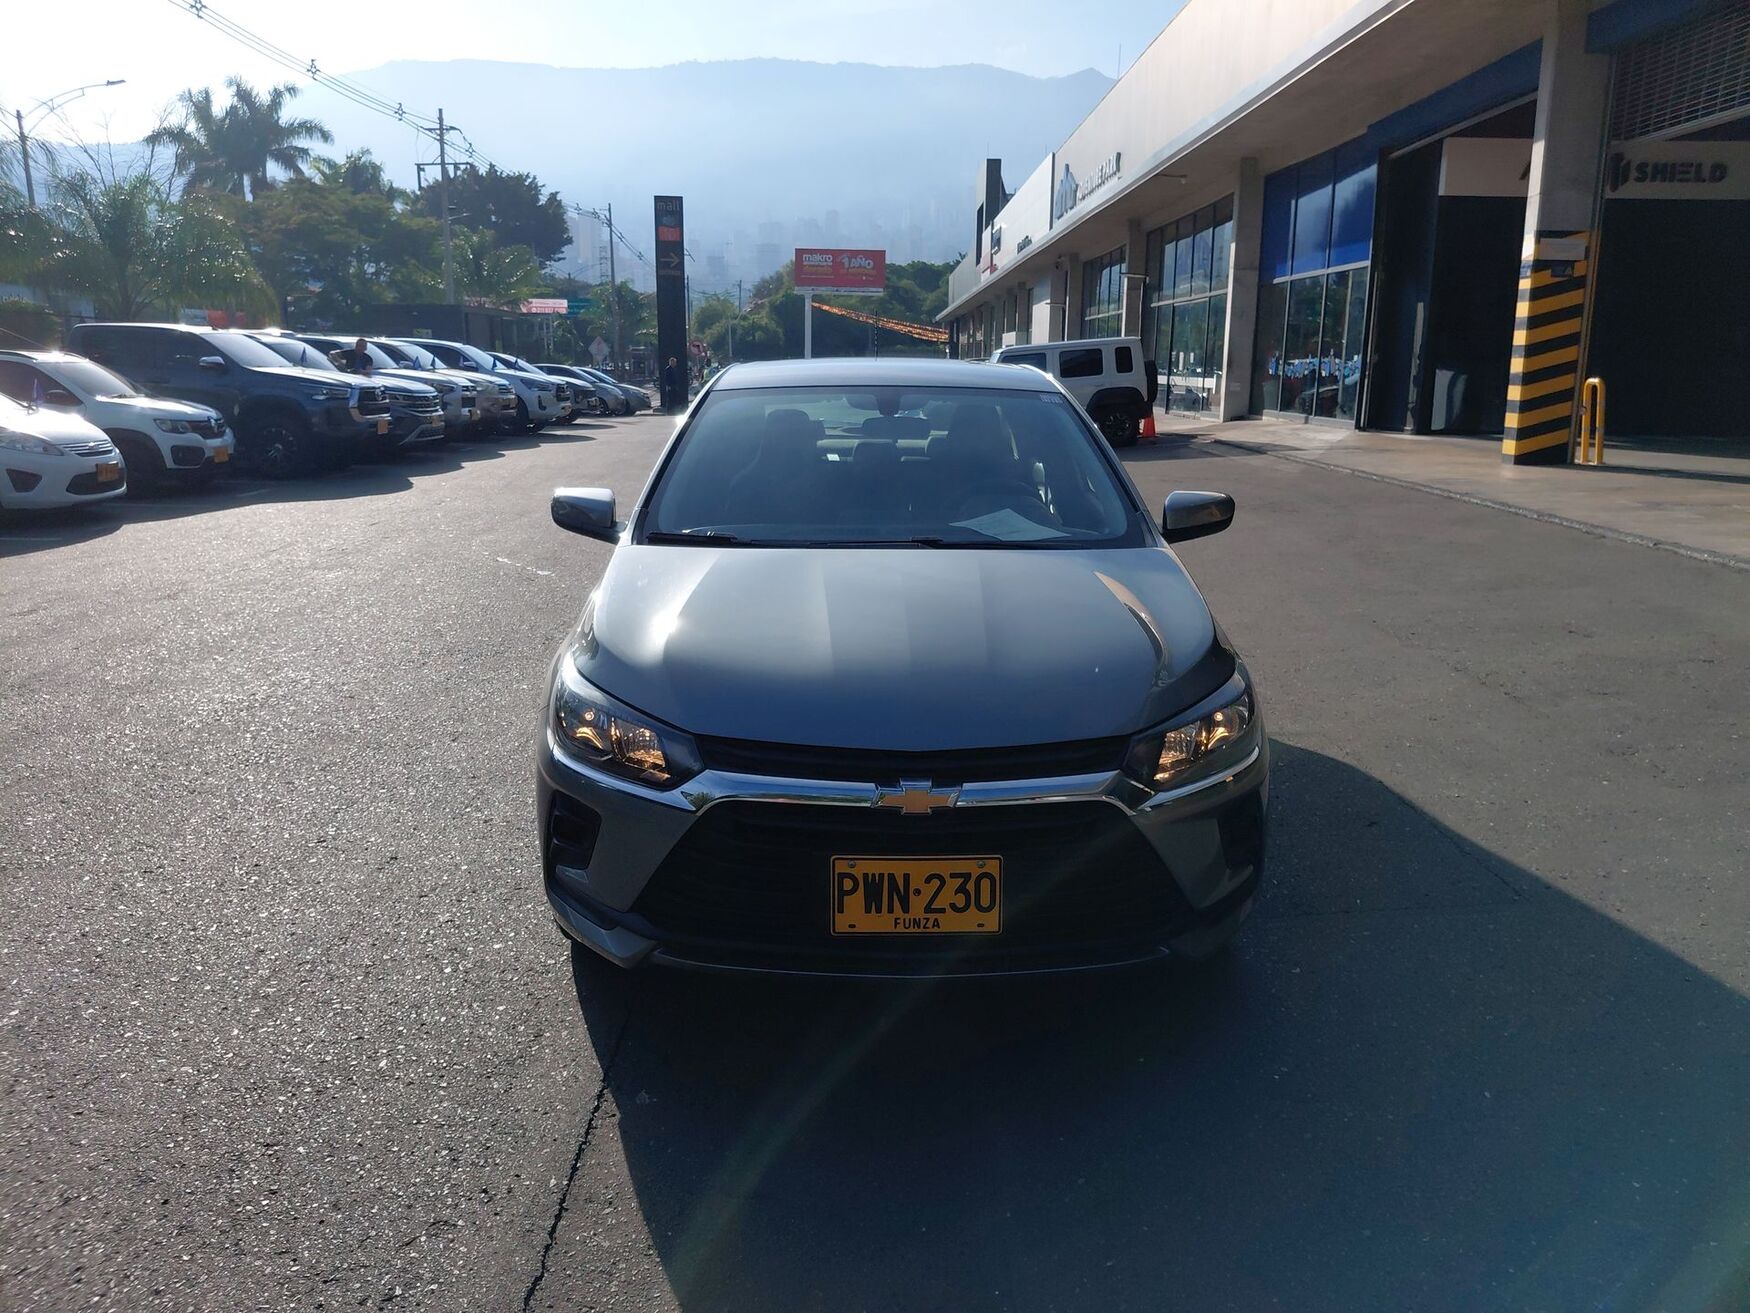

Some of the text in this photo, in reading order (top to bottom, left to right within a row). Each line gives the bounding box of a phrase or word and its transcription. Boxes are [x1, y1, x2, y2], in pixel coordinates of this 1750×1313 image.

[1633, 161, 1729, 183] SHIELD
[657, 200, 680, 211] mall
[803, 253, 833, 262] makro
[850, 255, 874, 269] AÑO
[894, 917, 941, 930] FUNZA
